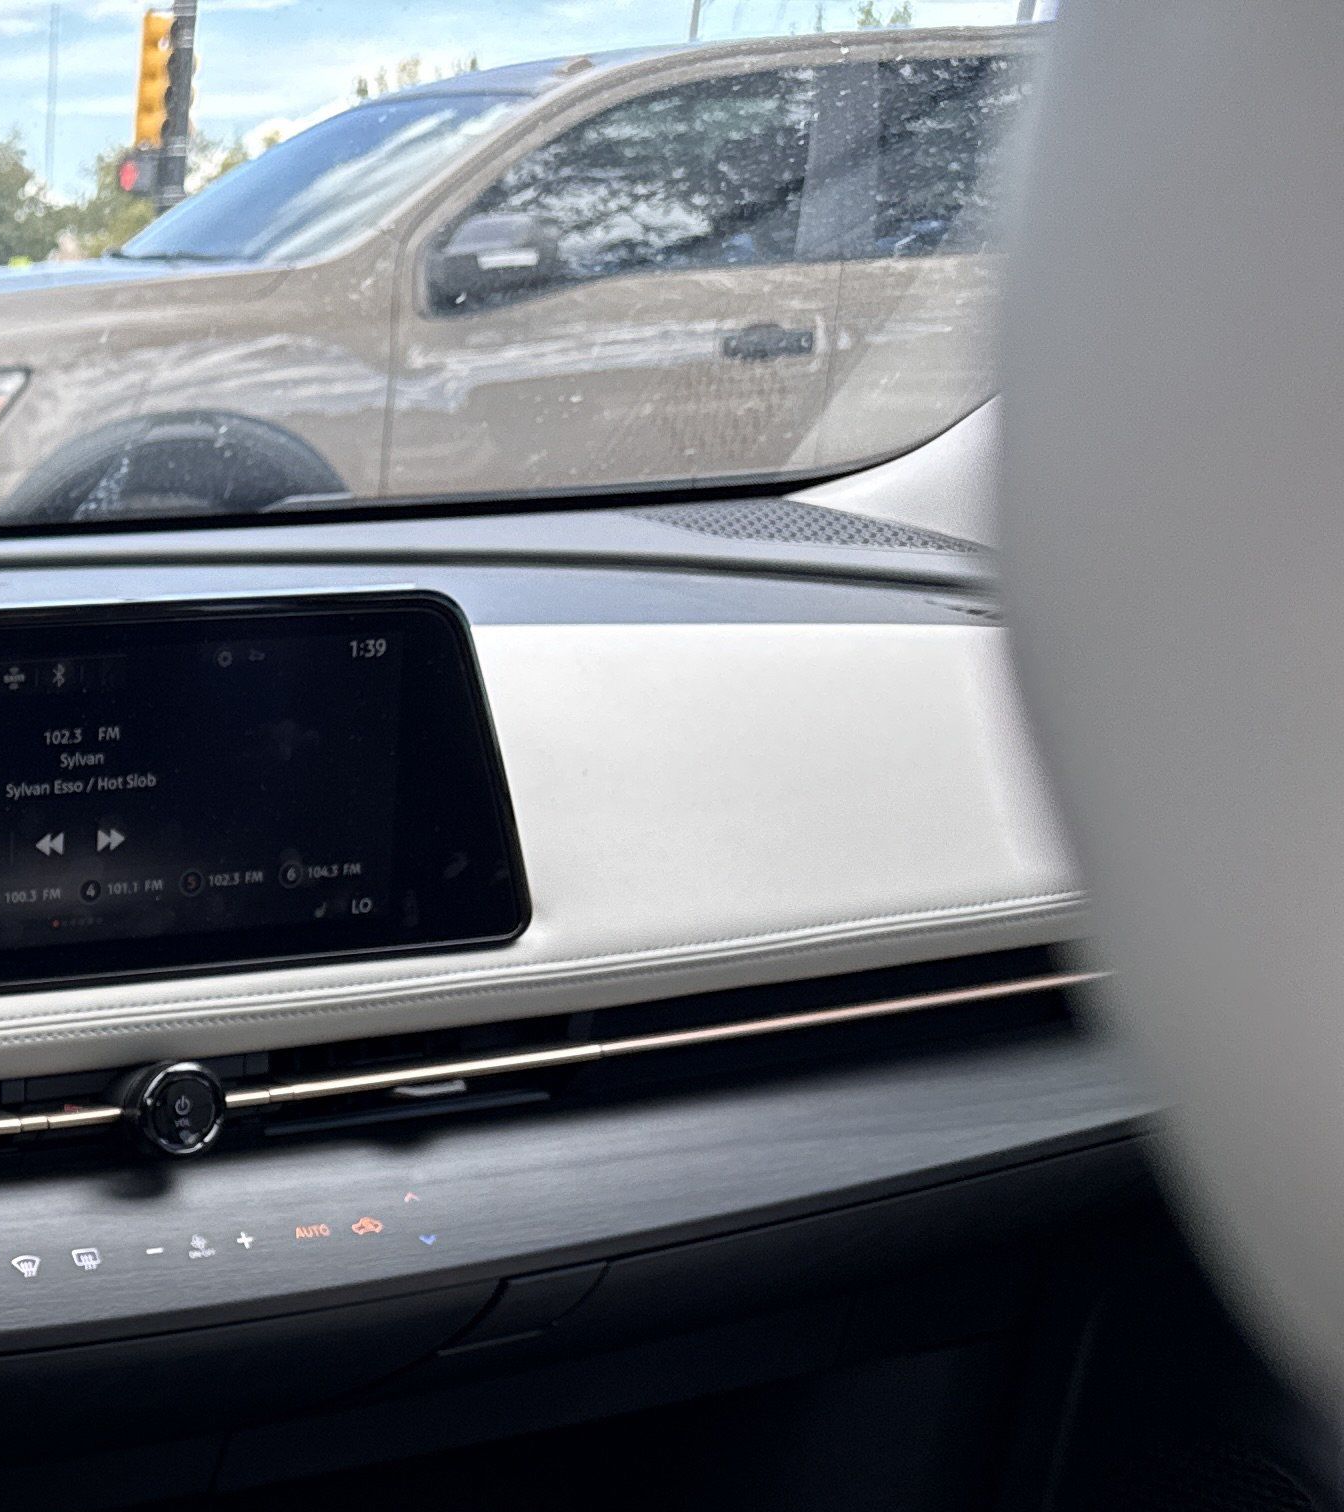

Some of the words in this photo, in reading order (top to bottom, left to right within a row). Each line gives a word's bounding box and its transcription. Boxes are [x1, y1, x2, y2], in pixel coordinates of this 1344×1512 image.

[349, 637, 387, 658] 1:39
[43, 728, 83, 745] 102.3
[97, 725, 121, 742] FM
[60, 752, 105, 770] Sylvan
[5, 781, 50, 801] Sylvan
[53, 779, 83, 795] Esso
[97, 776, 124, 791] Hot
[126, 772, 157, 789] Slob
[245, 870, 263, 884] FM
[286, 867, 297, 882] 6
[343, 862, 361, 876] FM
[4, 890, 37, 904] 100.3
[42, 888, 61, 901] FM
[85, 884, 96, 897] 4
[107, 882, 138, 896] 101.1
[144, 879, 163, 892] FM
[351, 897, 374, 915] LO
[295, 1223, 331, 1239] AUTO
